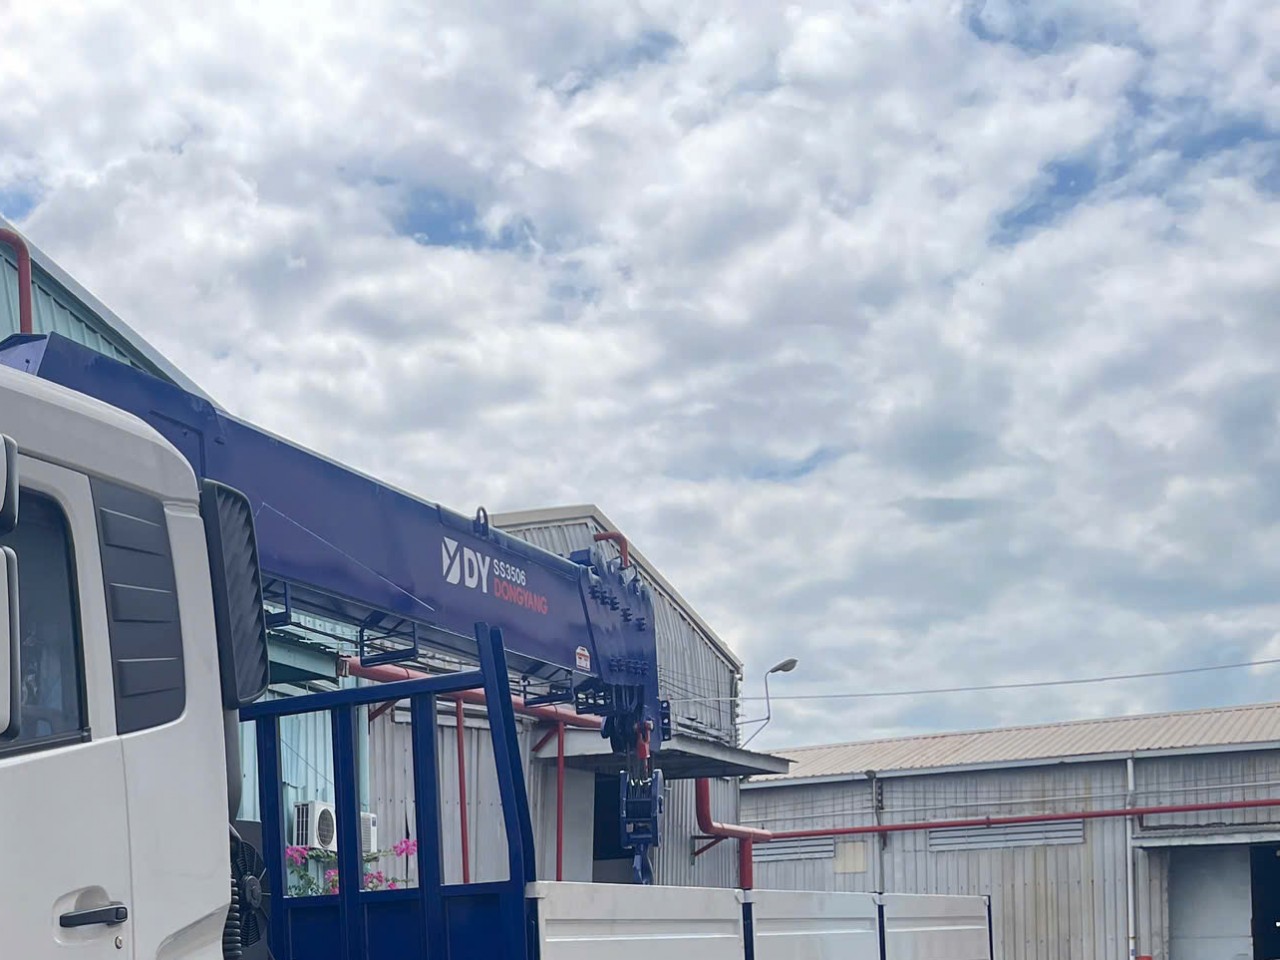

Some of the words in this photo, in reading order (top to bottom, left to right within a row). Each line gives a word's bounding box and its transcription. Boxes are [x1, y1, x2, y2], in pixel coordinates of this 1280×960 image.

[463, 546, 490, 593] DY
[493, 558, 526, 587] SS3506
[493, 577, 548, 615] DONGYANG
